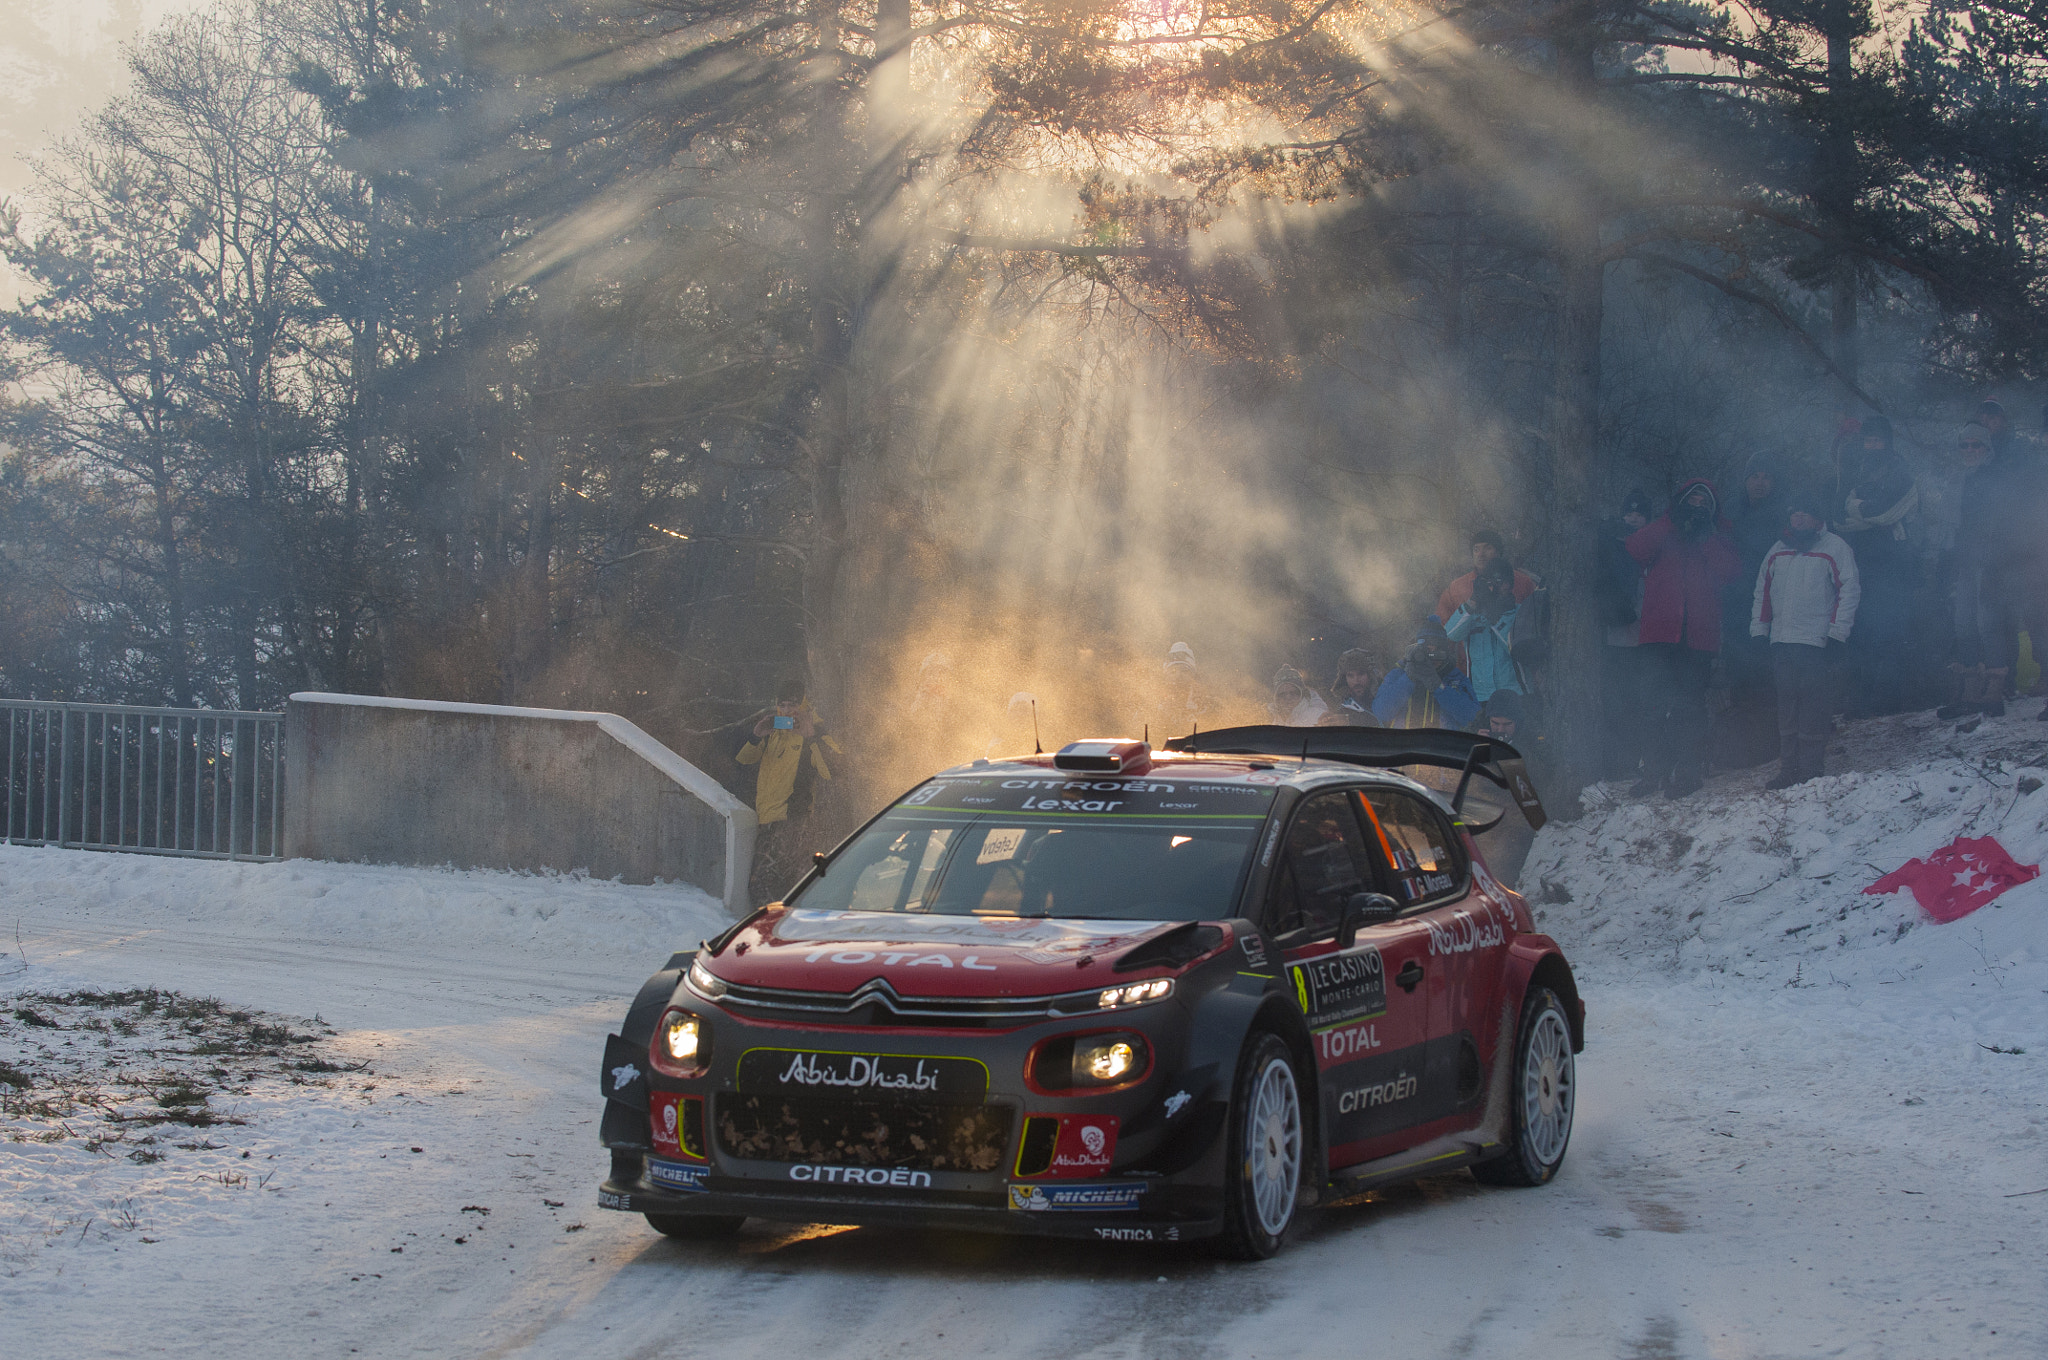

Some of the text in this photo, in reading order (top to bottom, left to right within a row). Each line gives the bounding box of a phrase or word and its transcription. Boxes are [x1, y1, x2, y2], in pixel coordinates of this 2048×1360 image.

[1001, 780, 1175, 793] CITROËN
[1021, 795, 1124, 812] Lexar
[1159, 801, 1200, 810] Lexar
[804, 950, 998, 971] TOTAL
[1312, 952, 1380, 989] LE CASINO
[1293, 965, 1308, 1015] 8
[1321, 980, 1380, 1005] MONTE-CARLO
[1317, 1024, 1381, 1059] TOTAL
[1339, 1072, 1417, 1115] CITROËN
[789, 1164, 931, 1188] CITROËN
